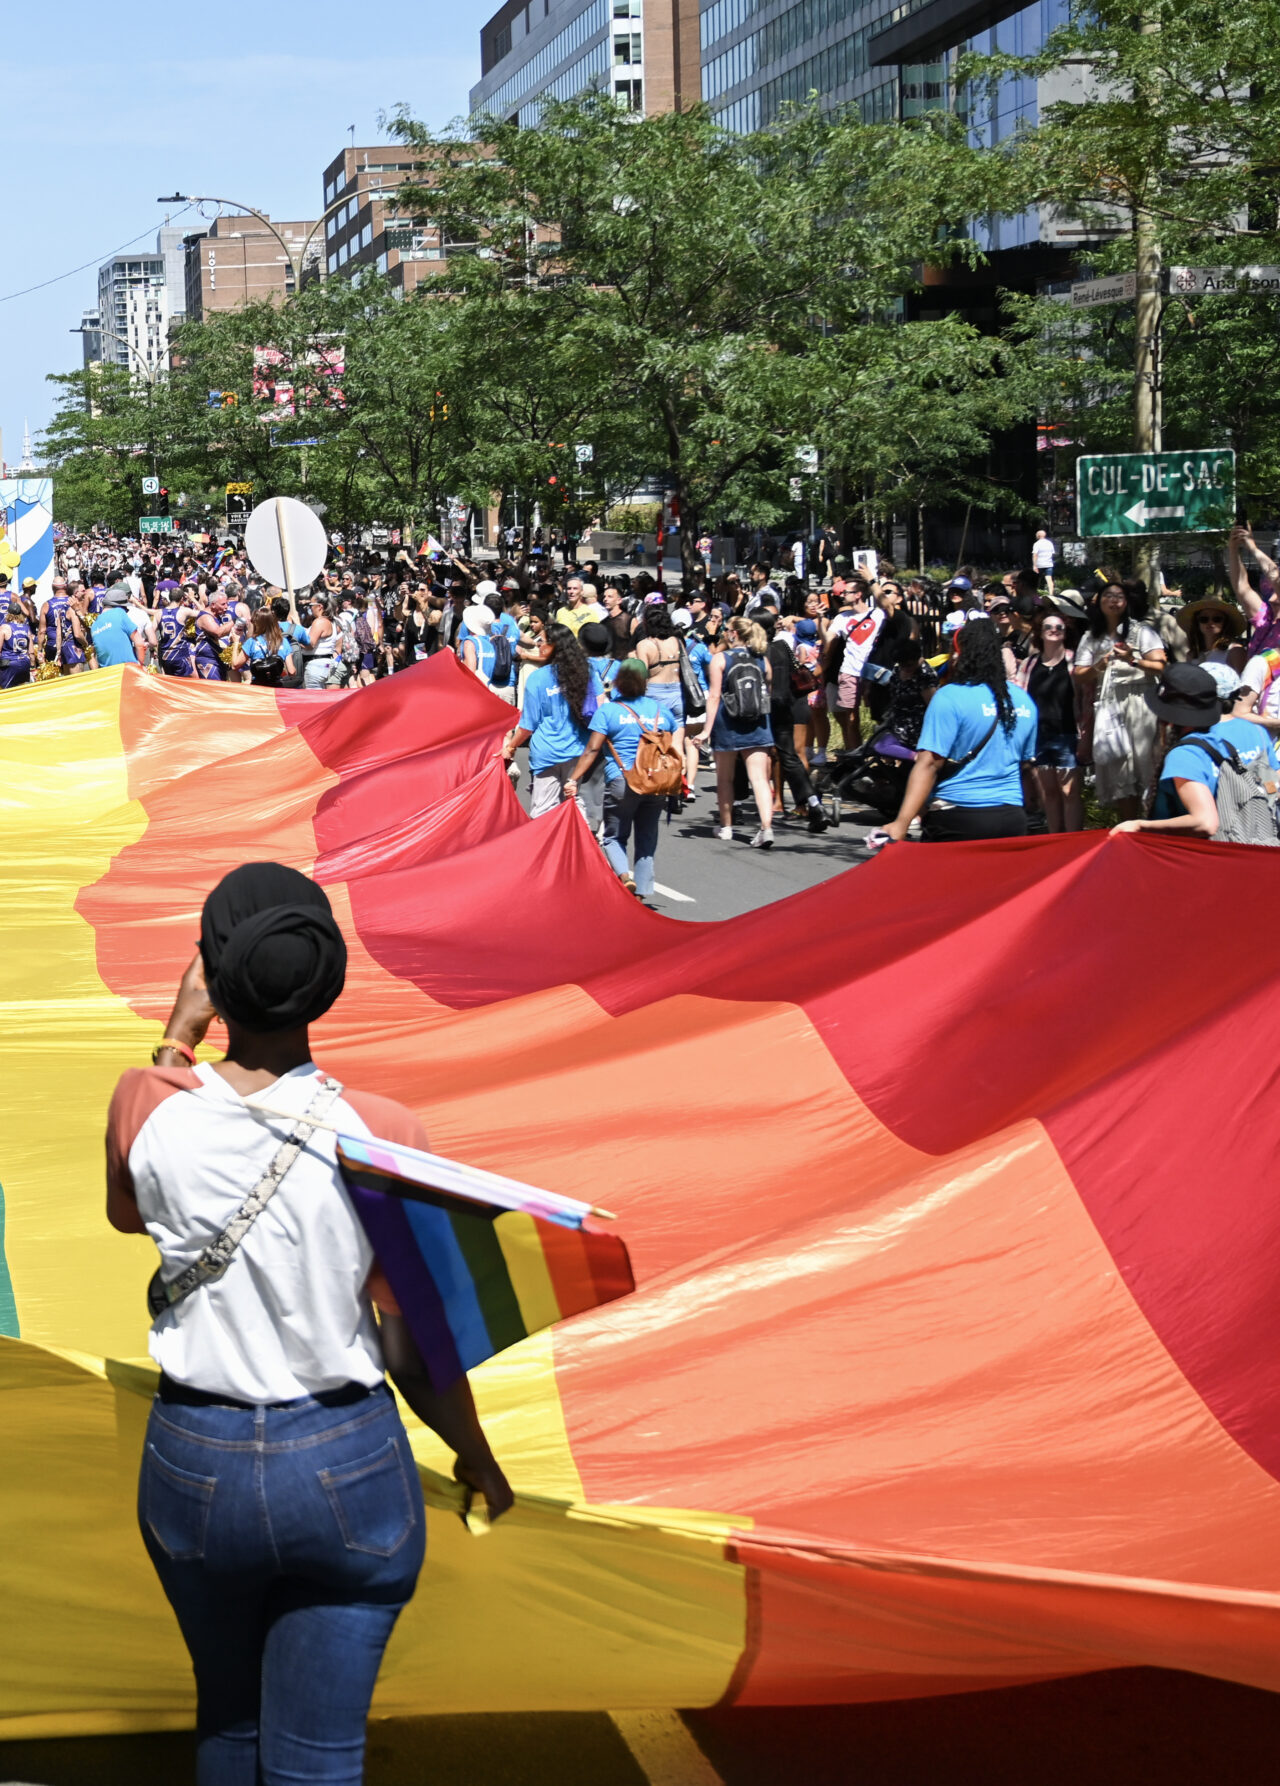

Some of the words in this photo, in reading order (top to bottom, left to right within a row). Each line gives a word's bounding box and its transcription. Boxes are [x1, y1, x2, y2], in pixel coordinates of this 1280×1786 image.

[208, 250, 216, 290] HOTEL
[1073, 285, 1124, 305] René-Lévesque
[1087, 459, 1226, 496] CUL-DE-SAC
